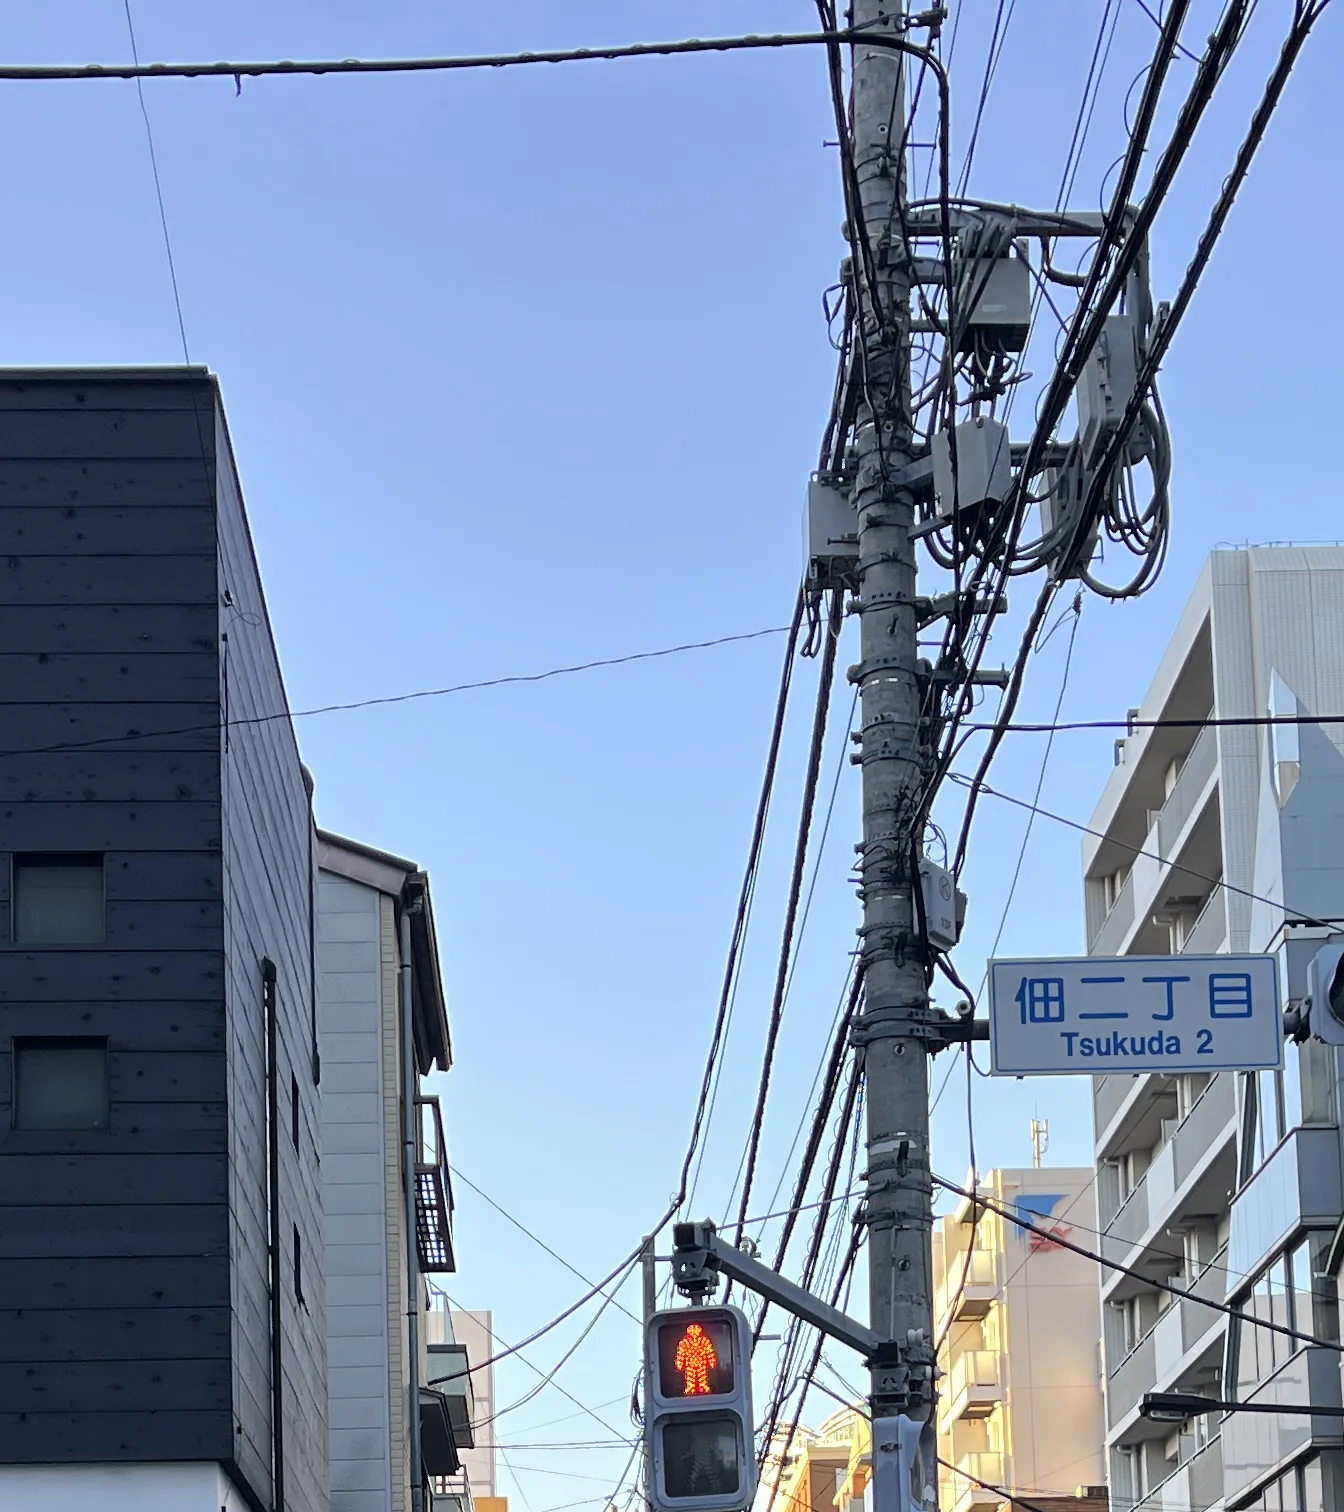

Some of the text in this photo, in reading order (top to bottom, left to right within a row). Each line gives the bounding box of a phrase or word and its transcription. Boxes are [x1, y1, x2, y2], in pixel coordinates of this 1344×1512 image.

[1014, 973, 1253, 1026] 佃二丁目
[1061, 1029, 1215, 1058] Tsukuda 2
